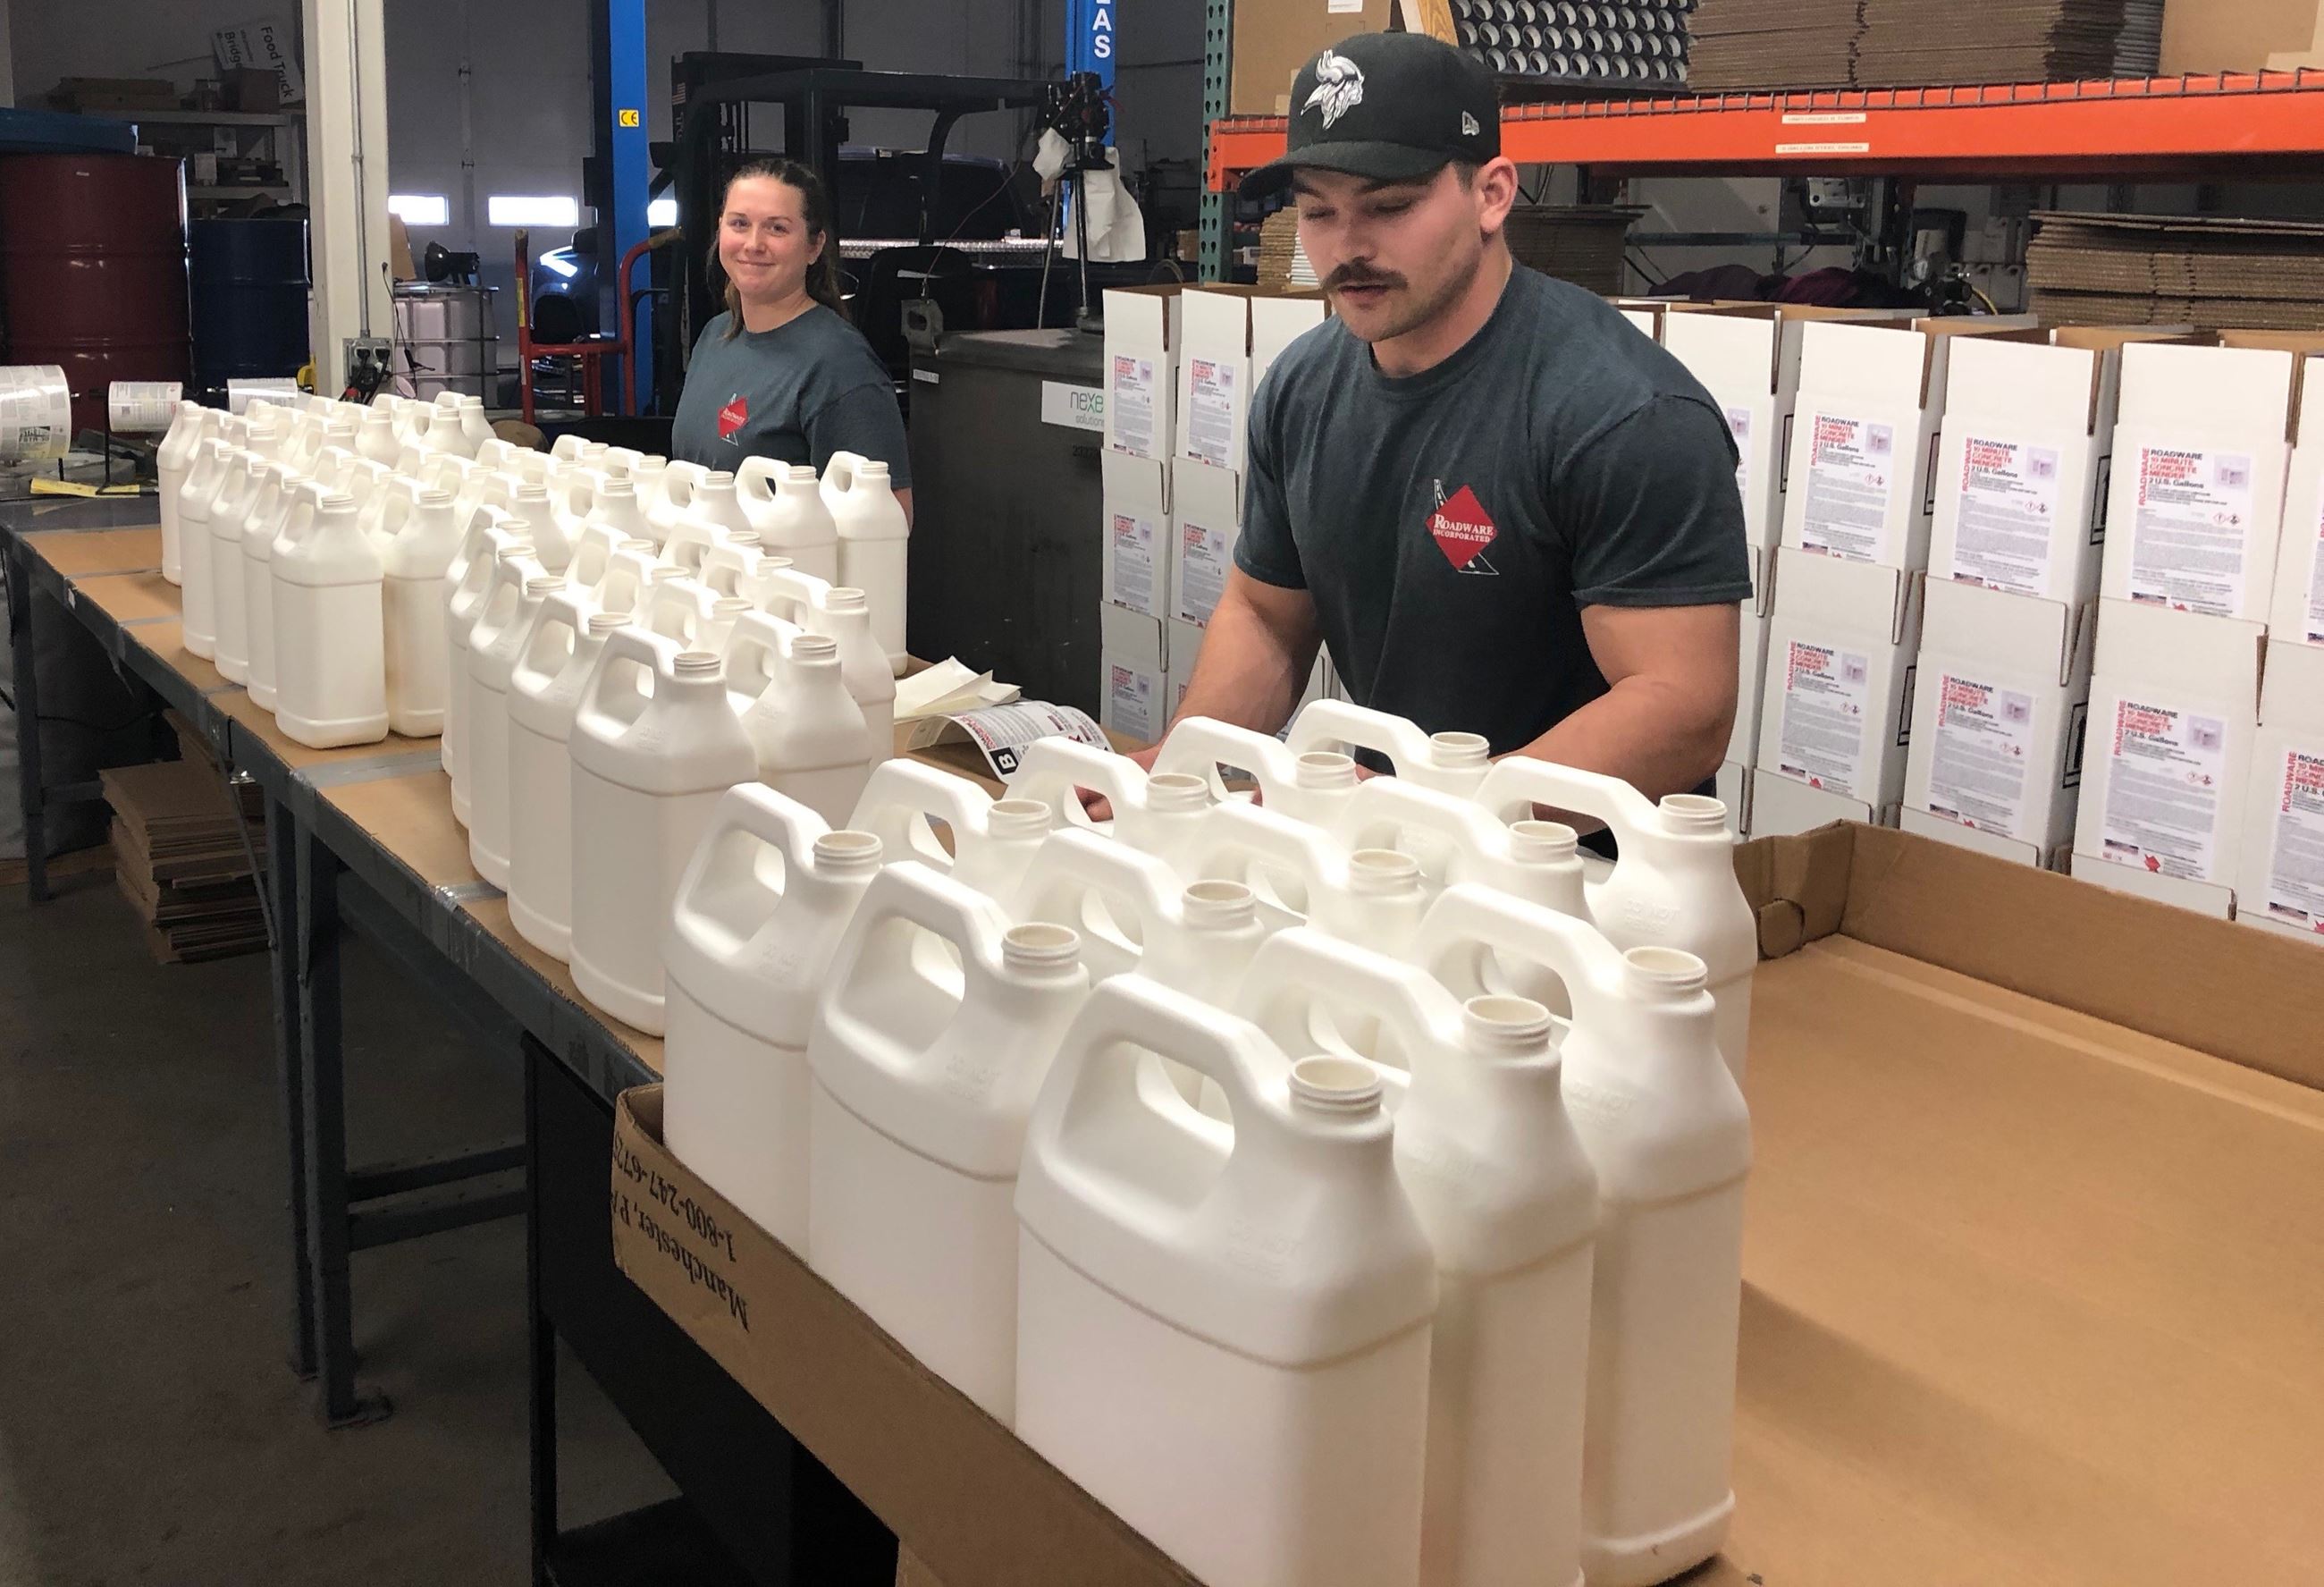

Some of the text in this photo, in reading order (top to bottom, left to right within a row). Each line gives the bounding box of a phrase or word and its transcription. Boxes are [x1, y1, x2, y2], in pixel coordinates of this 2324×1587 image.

[1092, 0, 1112, 58] AS
[260, 26, 294, 97] Food Truck
[1974, 439, 2017, 451] ROADWARE
[2151, 449, 2202, 460] ROADWARE
[2138, 447, 2150, 506] ROADWARE
[2173, 478, 2204, 489] Gallons
[1432, 528, 1491, 544] INCORPORATED
[2127, 703, 2178, 719] ROADWARE
[998, 754, 1017, 770] B
[2281, 751, 2297, 813] ROADWARE
[634, 1202, 750, 1333] Manchester,
